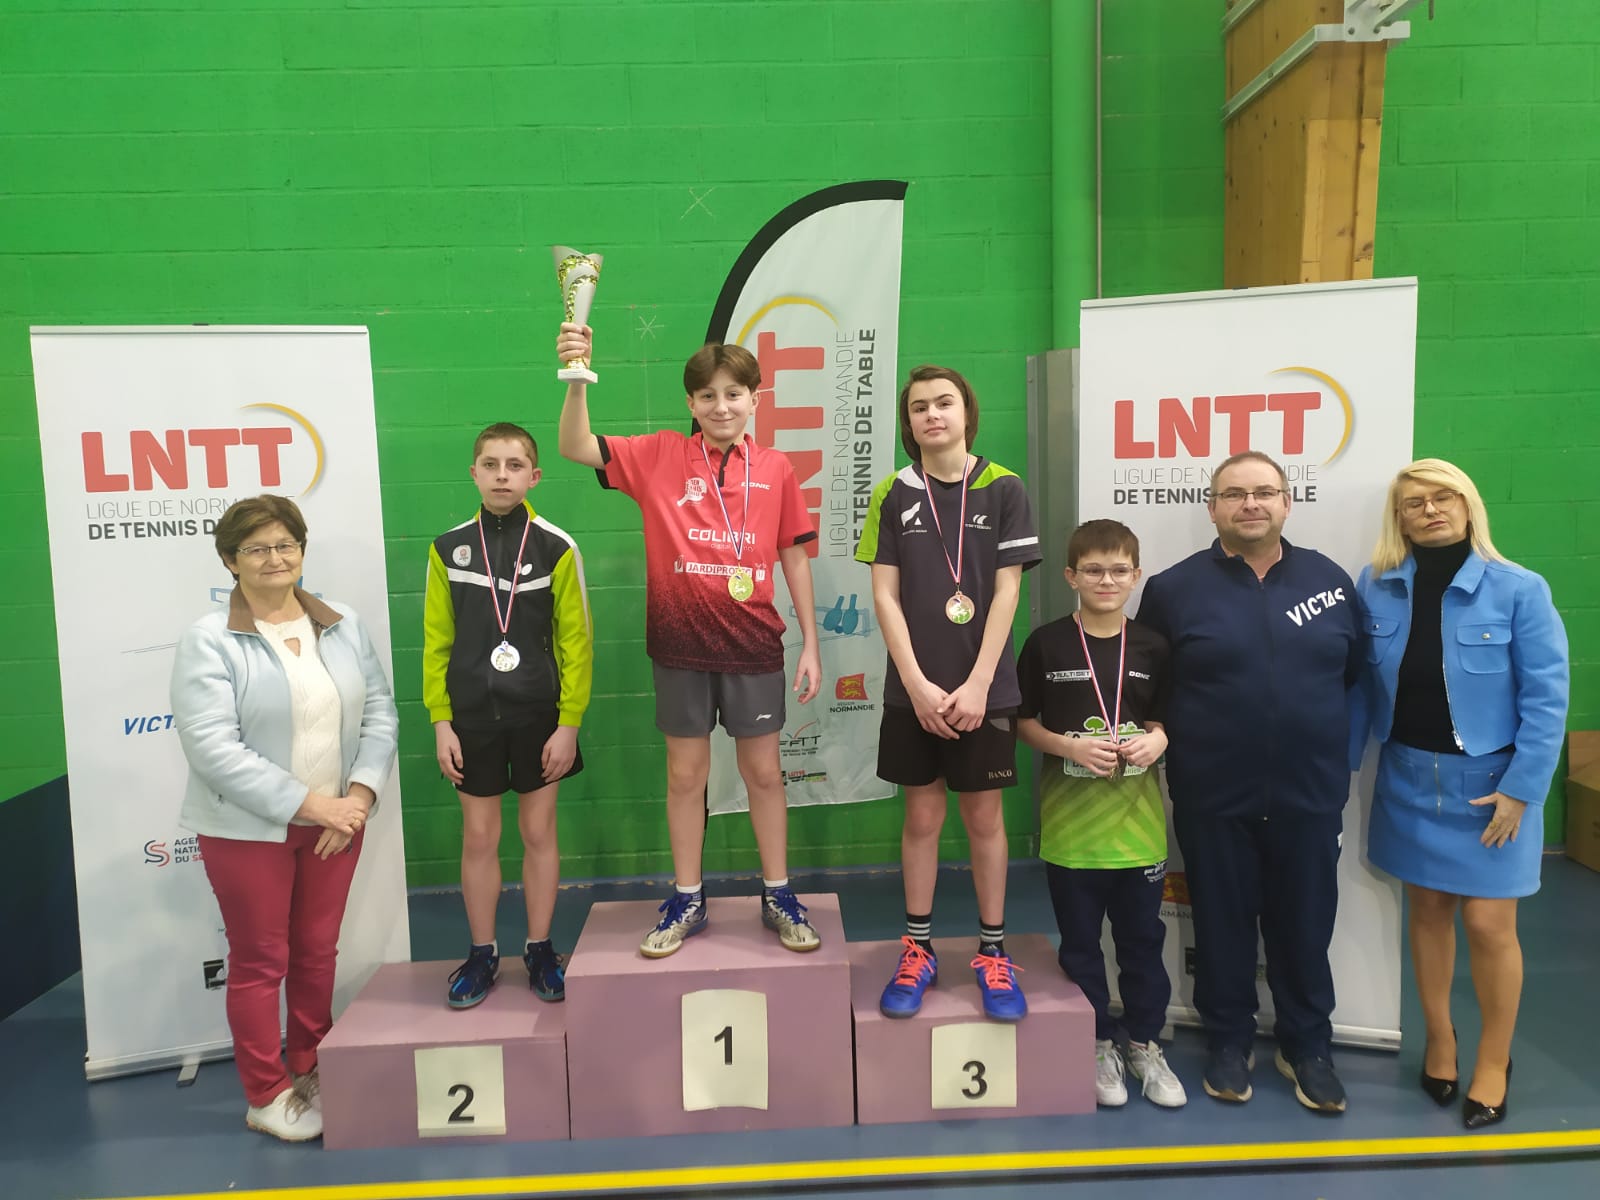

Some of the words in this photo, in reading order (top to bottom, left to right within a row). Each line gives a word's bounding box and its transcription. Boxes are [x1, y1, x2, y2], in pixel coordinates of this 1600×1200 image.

[856, 328, 876, 400] TABLE
[833, 330, 855, 458] NORMANDIE
[855, 405, 873, 435] DE
[1114, 391, 1322, 459] LNTT
[81, 427, 293, 493] LNTT
[831, 464, 849, 492] DE
[1112, 467, 1165, 485] LIGUE
[1170, 467, 1194, 484] DE
[853, 440, 872, 523] TENNIS
[1113, 488, 1139, 505] DE
[86, 500, 142, 520] LIGUE
[149, 500, 175, 517] DE
[88, 523, 116, 540] DE
[119, 520, 198, 538] TENNIS
[202, 518, 219, 536] D
[829, 499, 848, 558] LIGUE
[124, 714, 176, 735] VICT
[829, 704, 875, 713] NORMANDIE
[714, 1026, 734, 1065] 1
[961, 1060, 988, 1100] 3
[447, 1083, 476, 1125] 2
